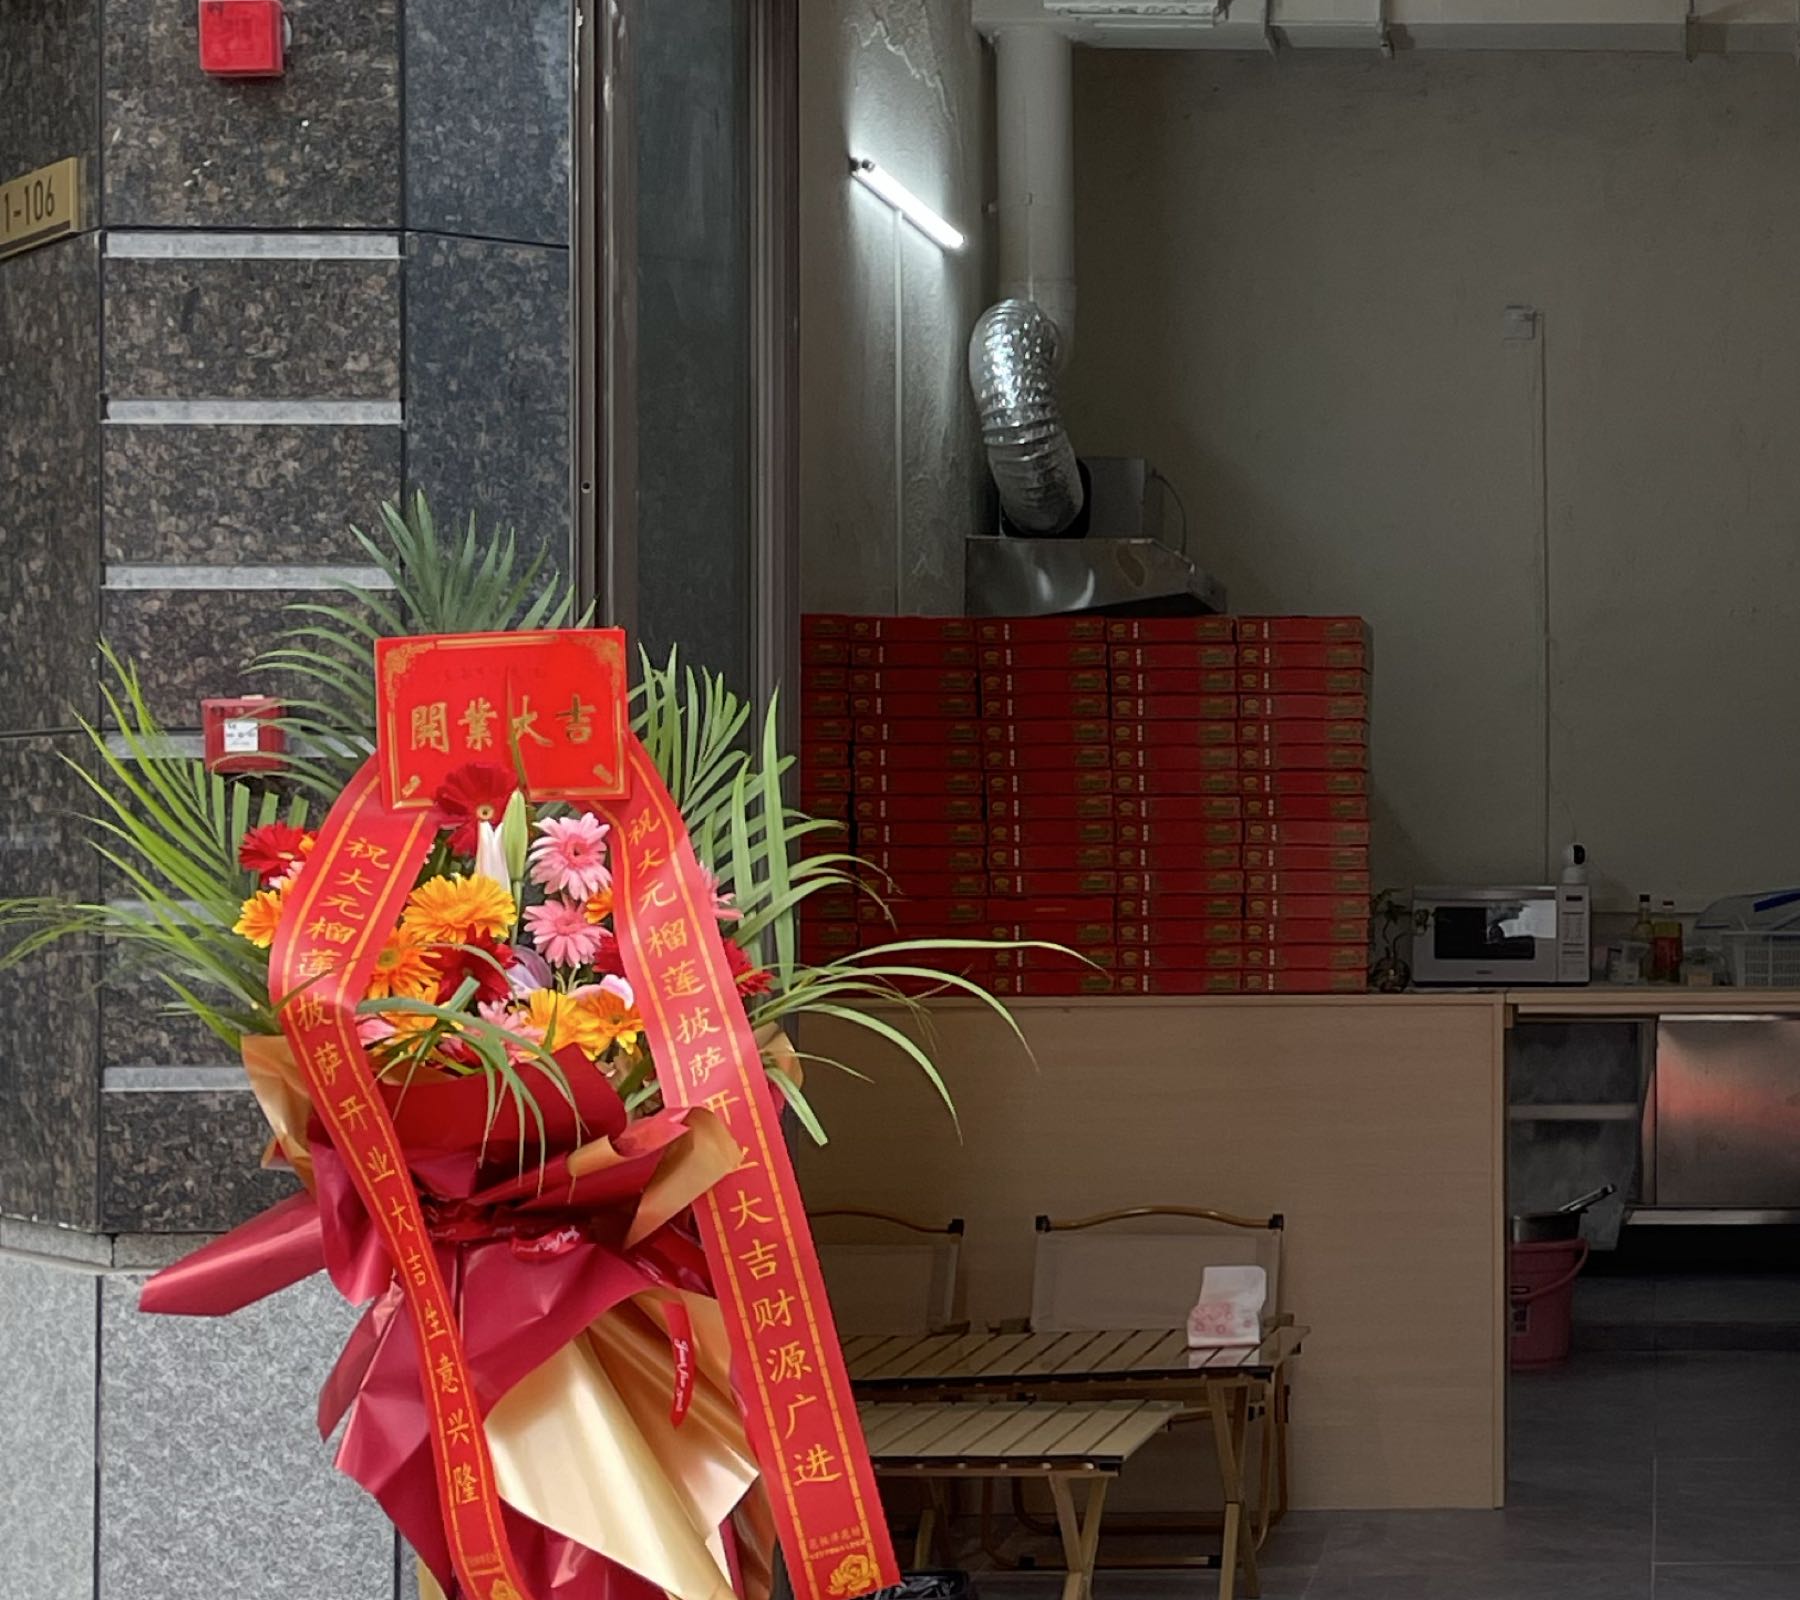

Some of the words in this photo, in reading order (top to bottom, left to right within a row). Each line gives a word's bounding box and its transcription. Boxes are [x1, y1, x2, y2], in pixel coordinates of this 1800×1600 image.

[3, 175, 57, 235] 1-106
[409, 692, 597, 755] 開業大吉
